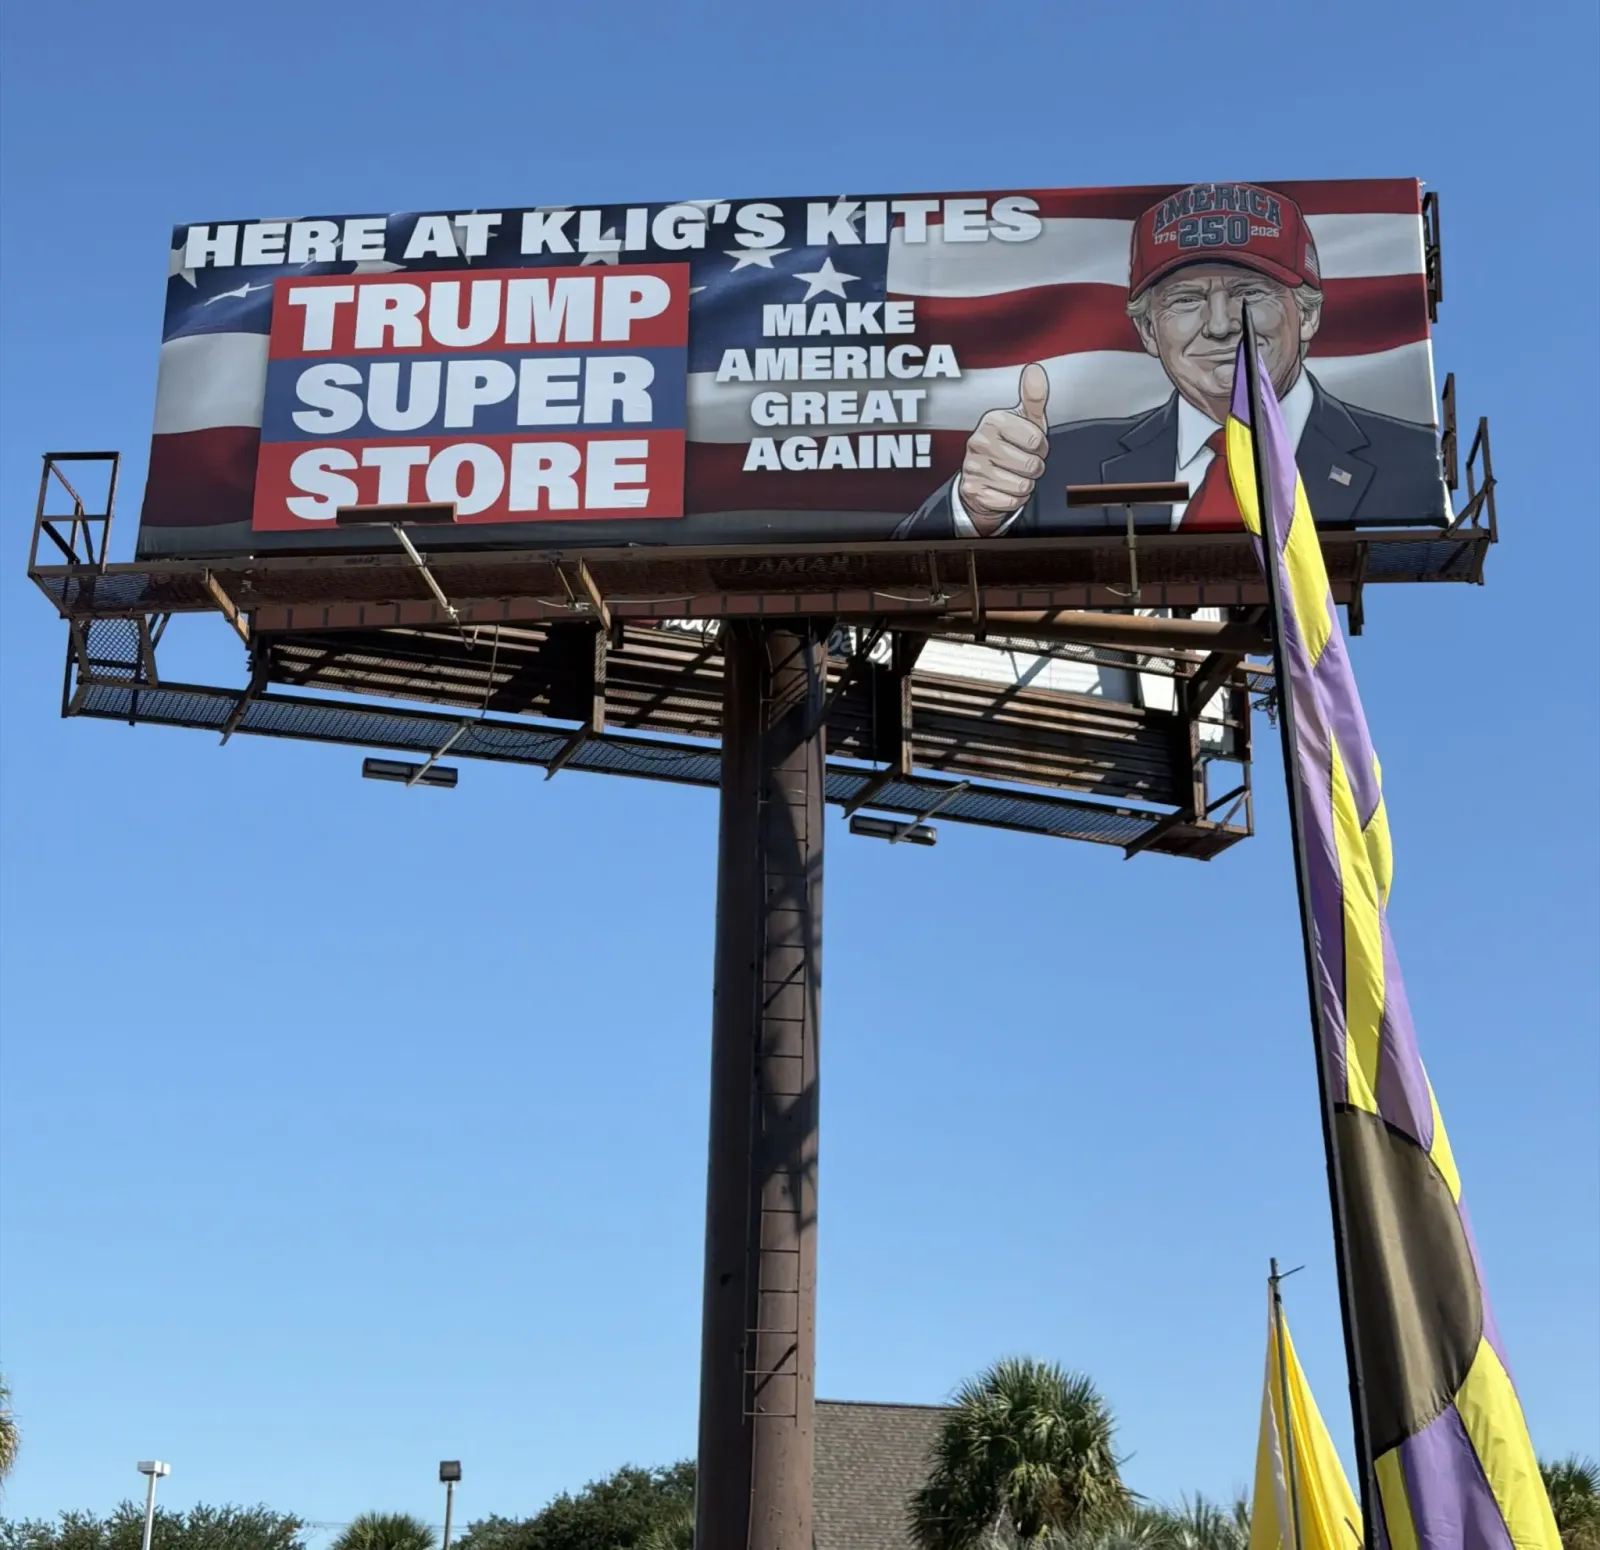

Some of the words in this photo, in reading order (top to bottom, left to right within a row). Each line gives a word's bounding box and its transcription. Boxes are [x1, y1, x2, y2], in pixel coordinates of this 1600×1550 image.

[1153, 184, 1282, 234] AMERICA
[184, 218, 387, 268] HERE
[403, 213, 502, 259] AT
[520, 203, 786, 255] KLIG'S
[806, 197, 1042, 246] KITES
[1154, 231, 1177, 245] 1776
[1178, 215, 1250, 249] 250
[288, 275, 671, 351] TRUMP
[762, 301, 916, 337] MAKE
[715, 344, 962, 382] AMERICA
[291, 355, 656, 434] SUPER
[750, 389, 926, 427] GREAT
[742, 434, 932, 472] AGAIN!
[285, 439, 651, 521] STORE
